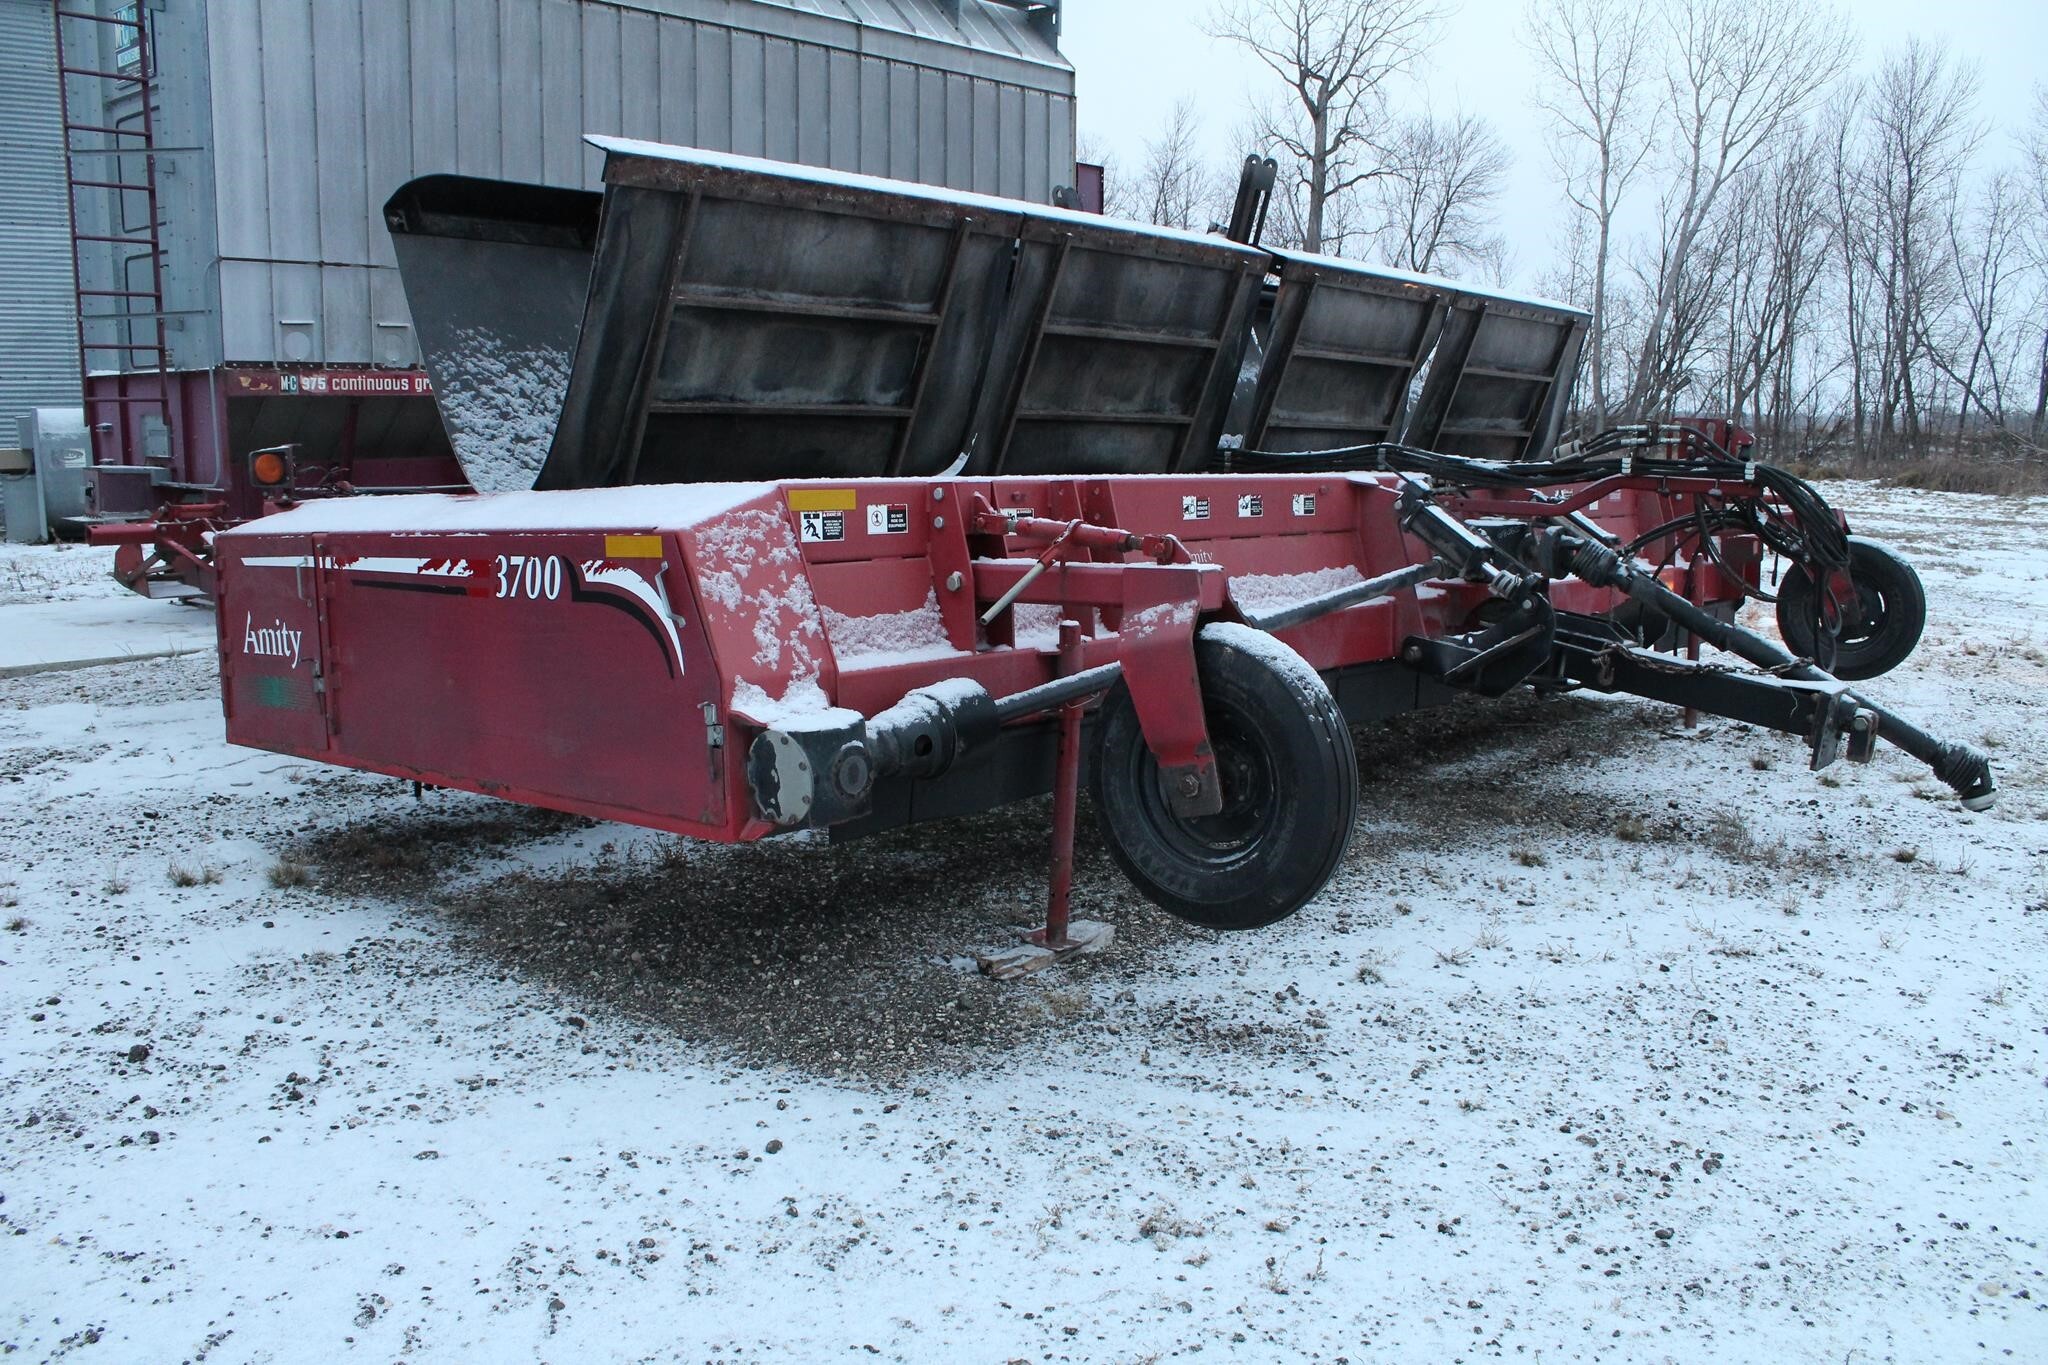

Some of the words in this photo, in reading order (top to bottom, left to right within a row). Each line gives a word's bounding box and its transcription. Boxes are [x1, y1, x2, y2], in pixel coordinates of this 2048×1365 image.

[302, 376, 326, 390] 975
[332, 375, 409, 391] continuous
[495, 554, 561, 600] 3700
[243, 610, 302, 669] Amity
